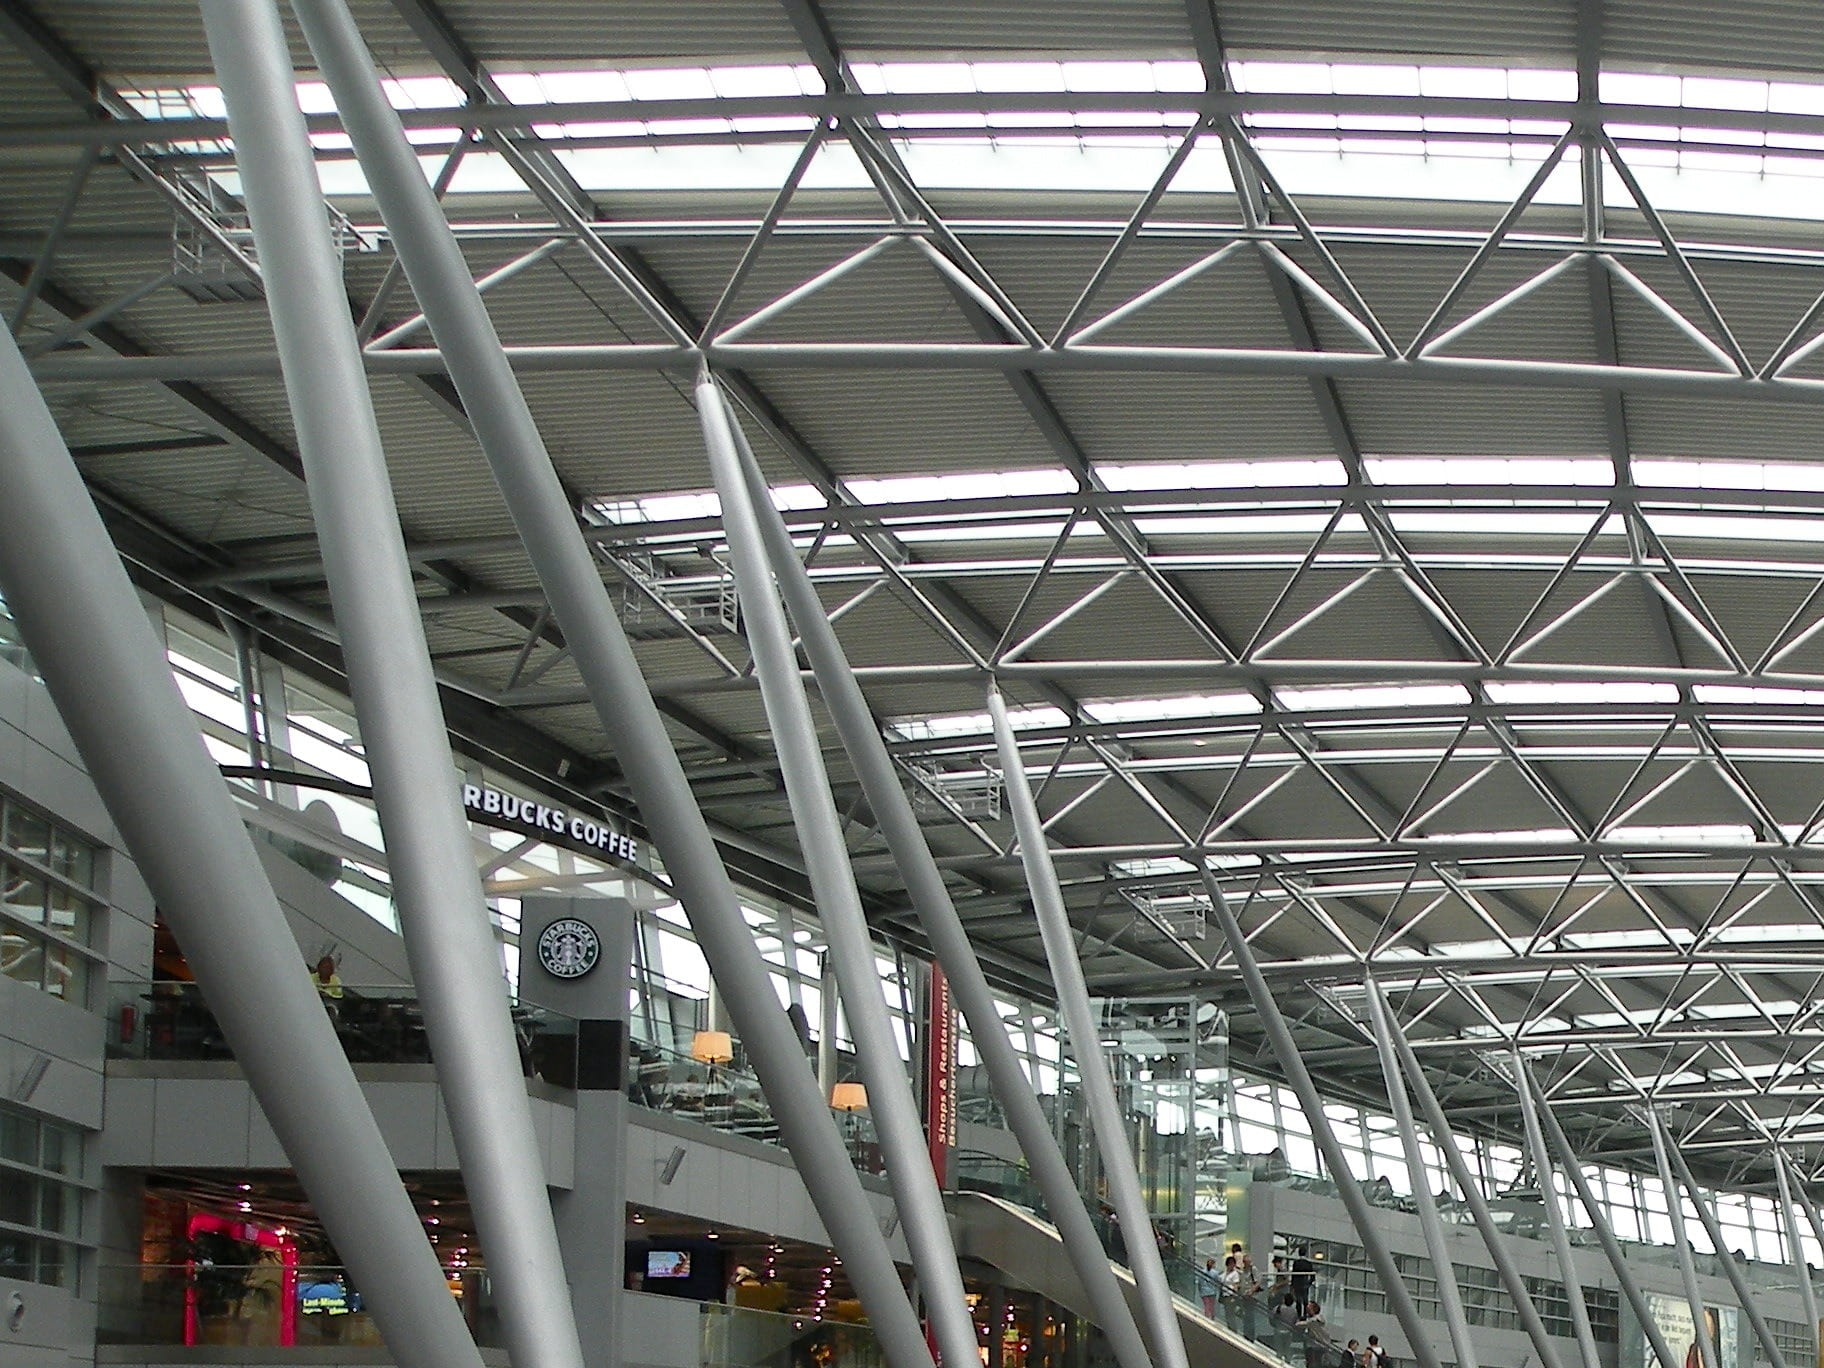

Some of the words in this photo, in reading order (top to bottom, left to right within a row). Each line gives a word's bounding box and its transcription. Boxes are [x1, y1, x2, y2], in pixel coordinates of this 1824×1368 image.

[570, 816, 638, 863] COFFEE
[542, 921, 595, 949] STARBUCKS
[547, 958, 590, 975] COFFEE
[938, 976, 949, 1073] Restaurants
[938, 1077, 948, 1091] &
[937, 1092, 948, 1145] Shops
